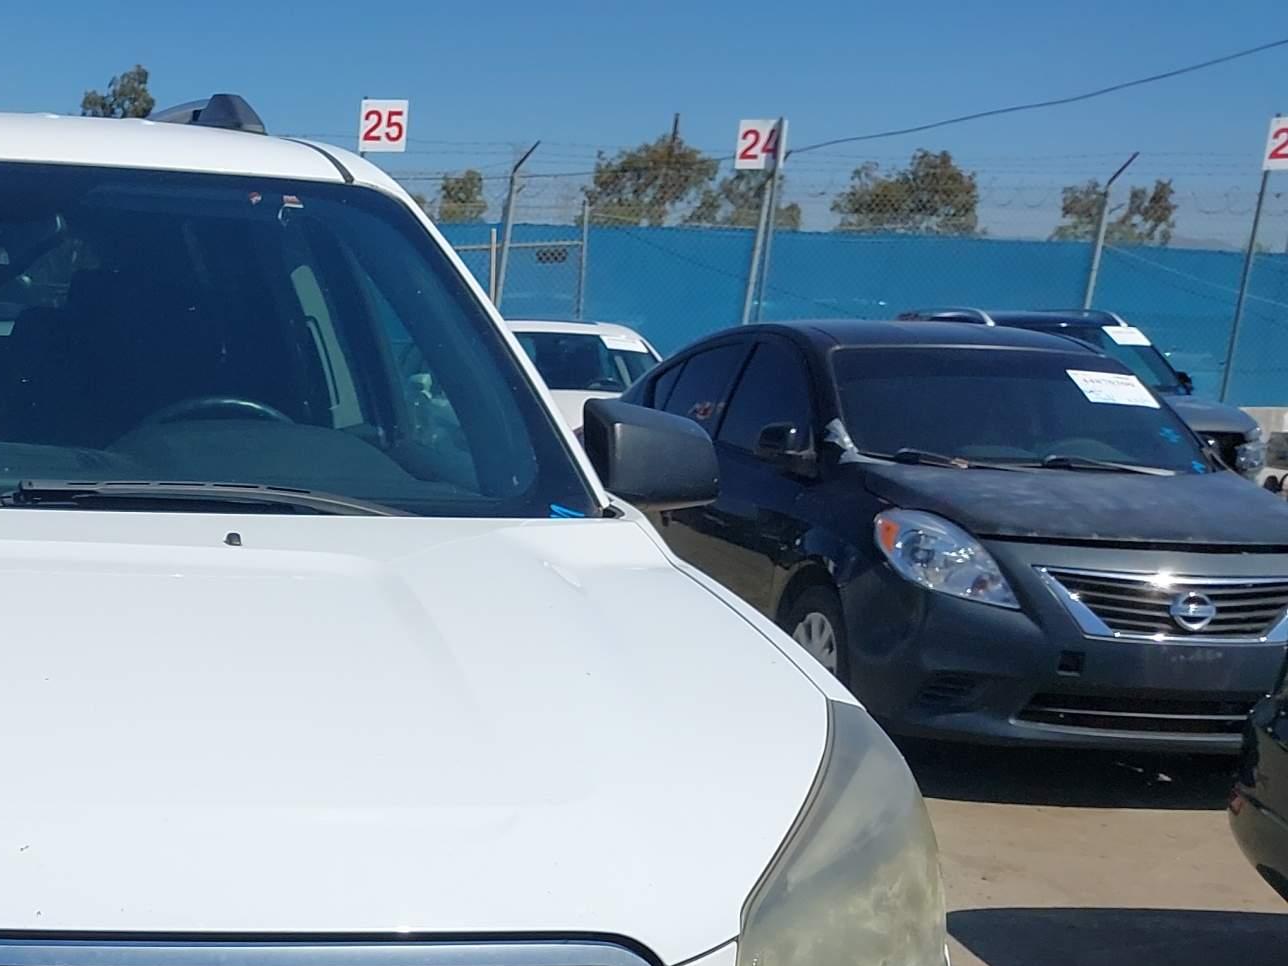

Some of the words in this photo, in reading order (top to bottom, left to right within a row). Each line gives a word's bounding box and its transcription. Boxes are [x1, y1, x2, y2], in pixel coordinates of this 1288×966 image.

[363, 110, 403, 142] 25
[739, 129, 778, 160] 24
[1268, 128, 1288, 160] 2
